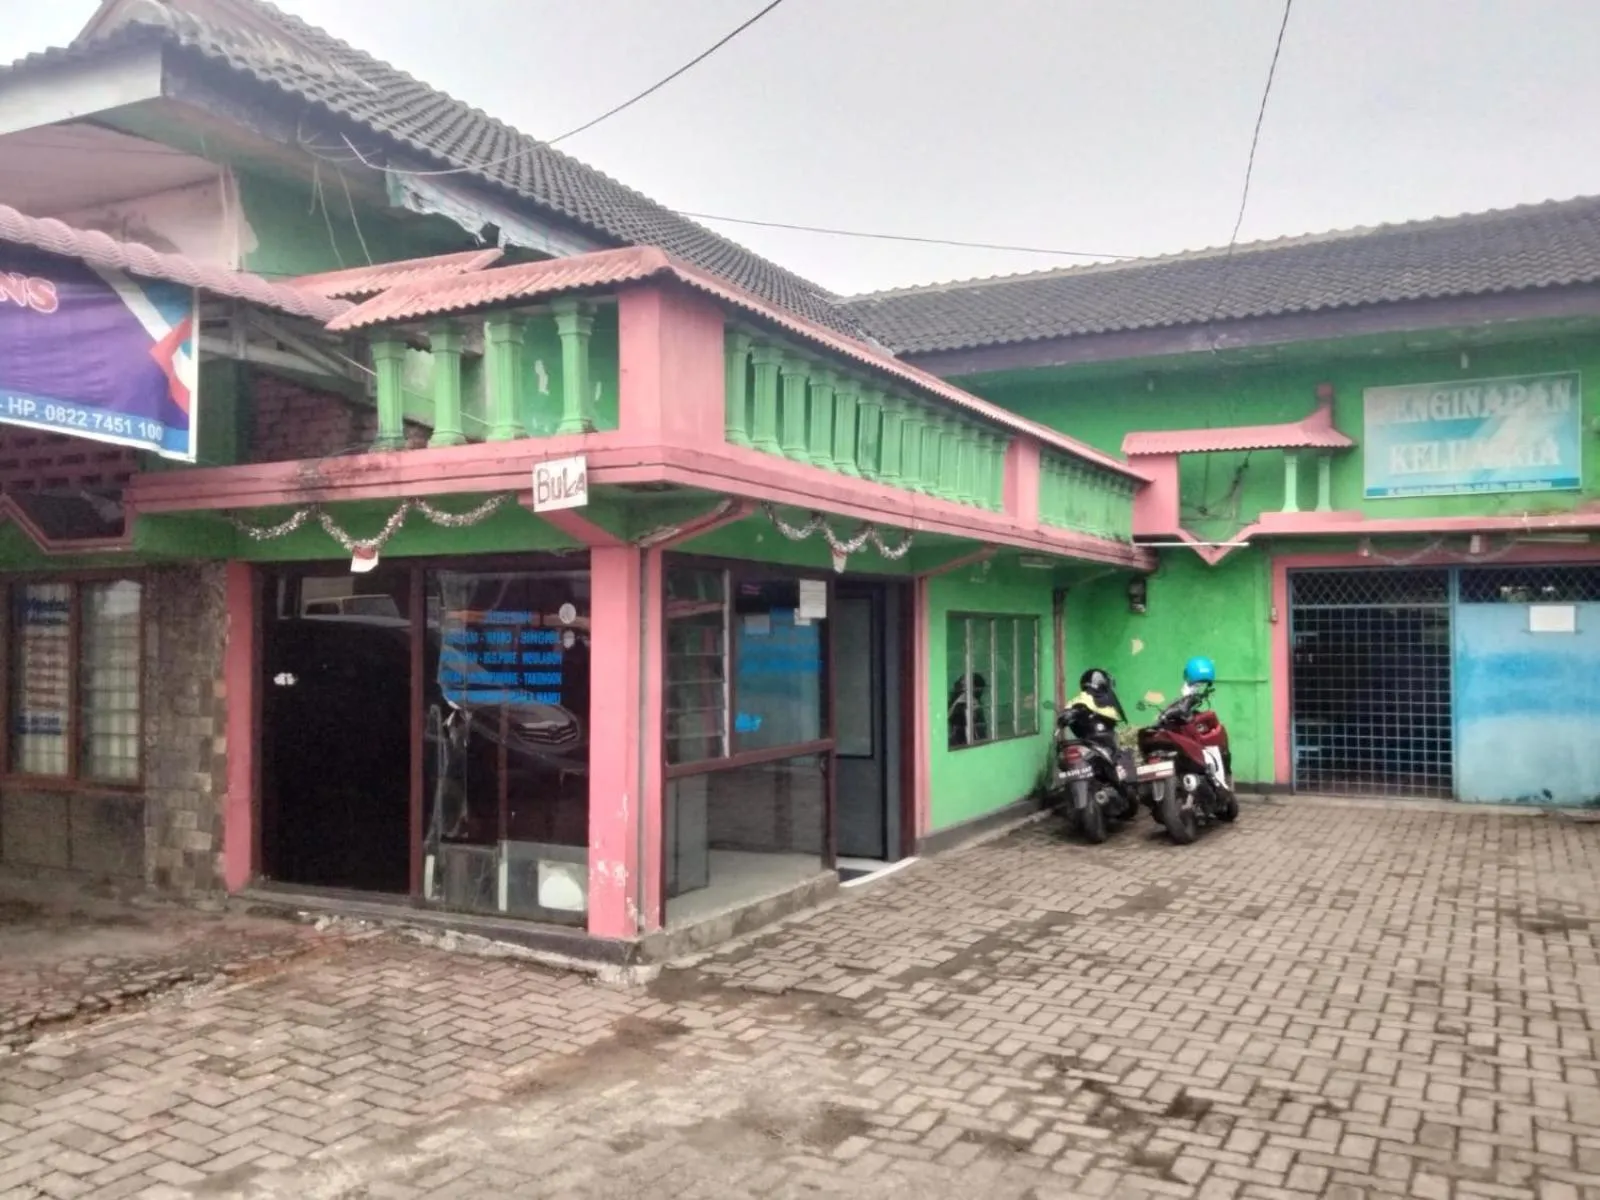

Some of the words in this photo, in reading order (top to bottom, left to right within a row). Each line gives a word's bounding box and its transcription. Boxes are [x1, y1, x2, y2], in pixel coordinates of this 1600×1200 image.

[8, 396, 39, 418] HP.
[44, 404, 88, 428] 0822
[92, 413, 132, 435] 7451
[1372, 378, 1572, 424] ENGINAPAN
[1388, 435, 1562, 474] KELUA
